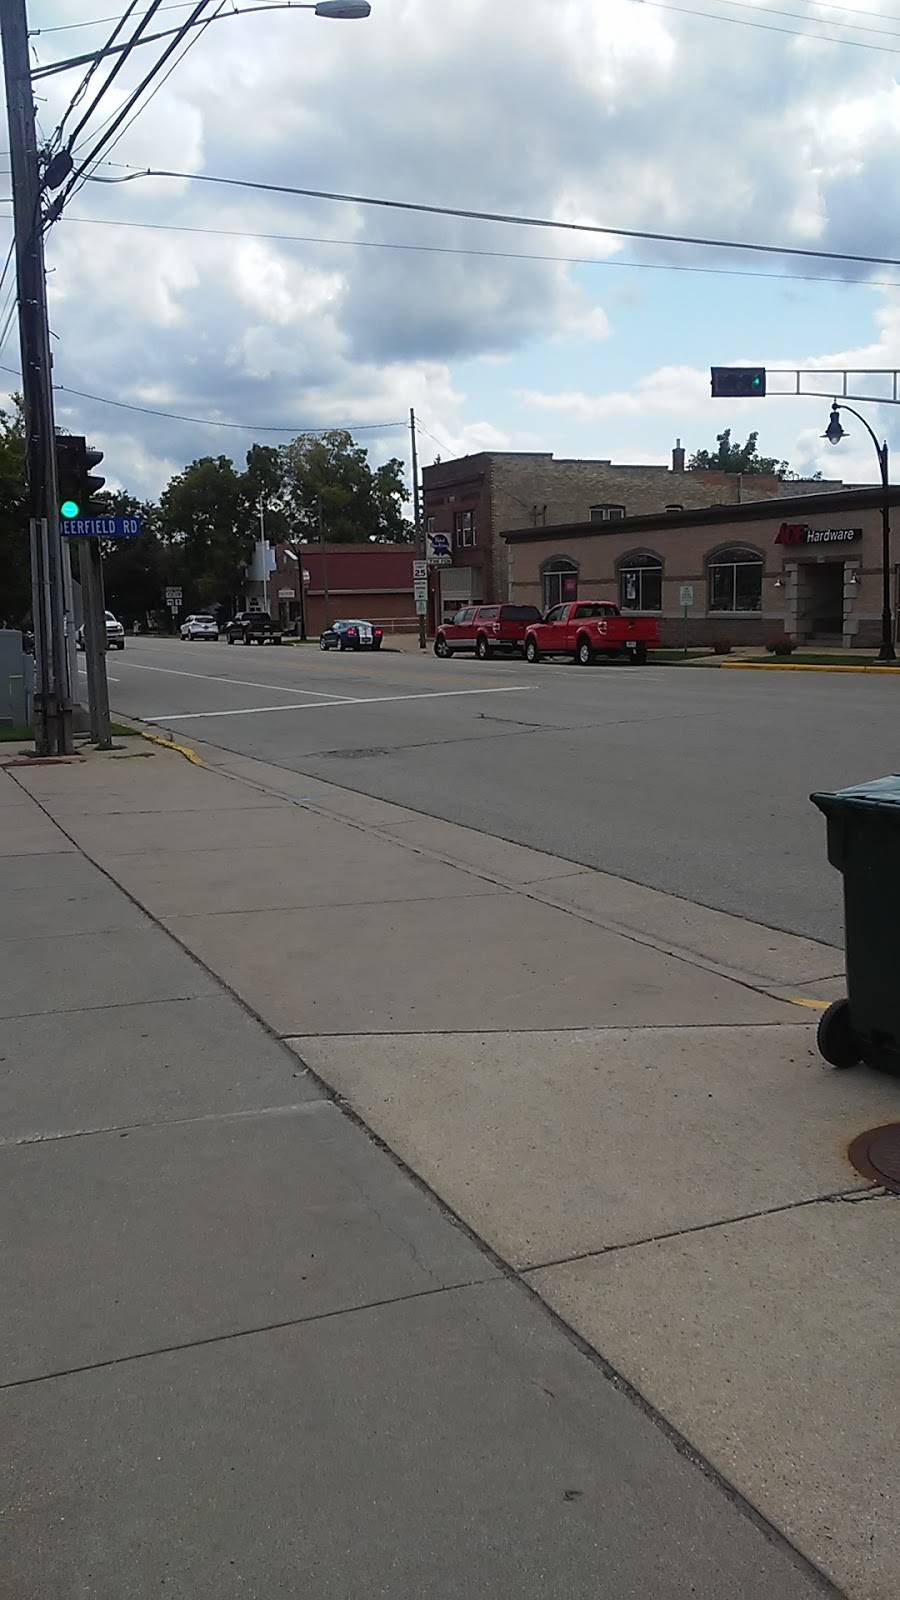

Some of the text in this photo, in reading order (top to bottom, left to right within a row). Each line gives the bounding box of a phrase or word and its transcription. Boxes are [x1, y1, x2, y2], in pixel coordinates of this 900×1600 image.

[123, 520, 138, 533] RD
[806, 529, 854, 543] Hardware
[415, 569, 426, 577] 25
